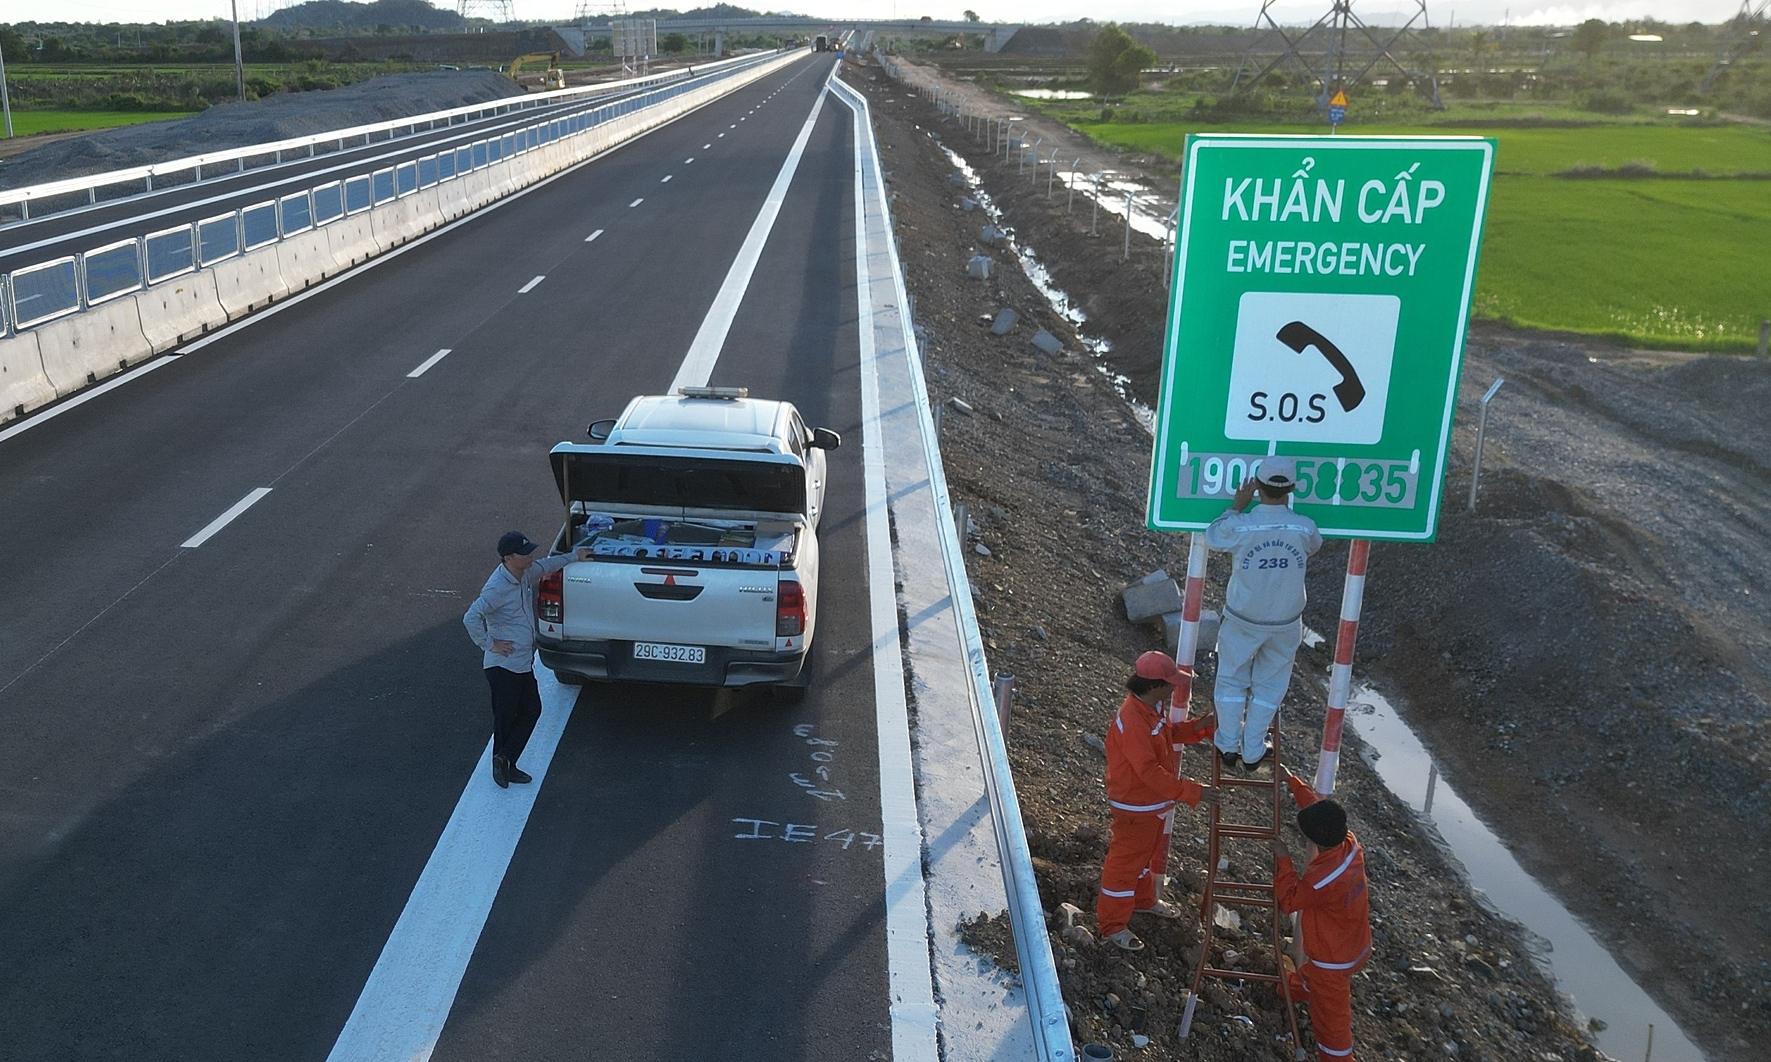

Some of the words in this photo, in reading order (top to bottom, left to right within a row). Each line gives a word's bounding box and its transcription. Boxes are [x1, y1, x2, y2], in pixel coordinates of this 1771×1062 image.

[1221, 157, 1345, 223] KHẨN
[1357, 162, 1446, 224] CẤP
[1226, 239, 1426, 277] EMERGENCY
[1246, 391, 1327, 423] S.O.S
[1258, 557, 1289, 570] 238
[567, 576, 592, 584] TOYOTA
[635, 643, 704, 663] 29C-932.83
